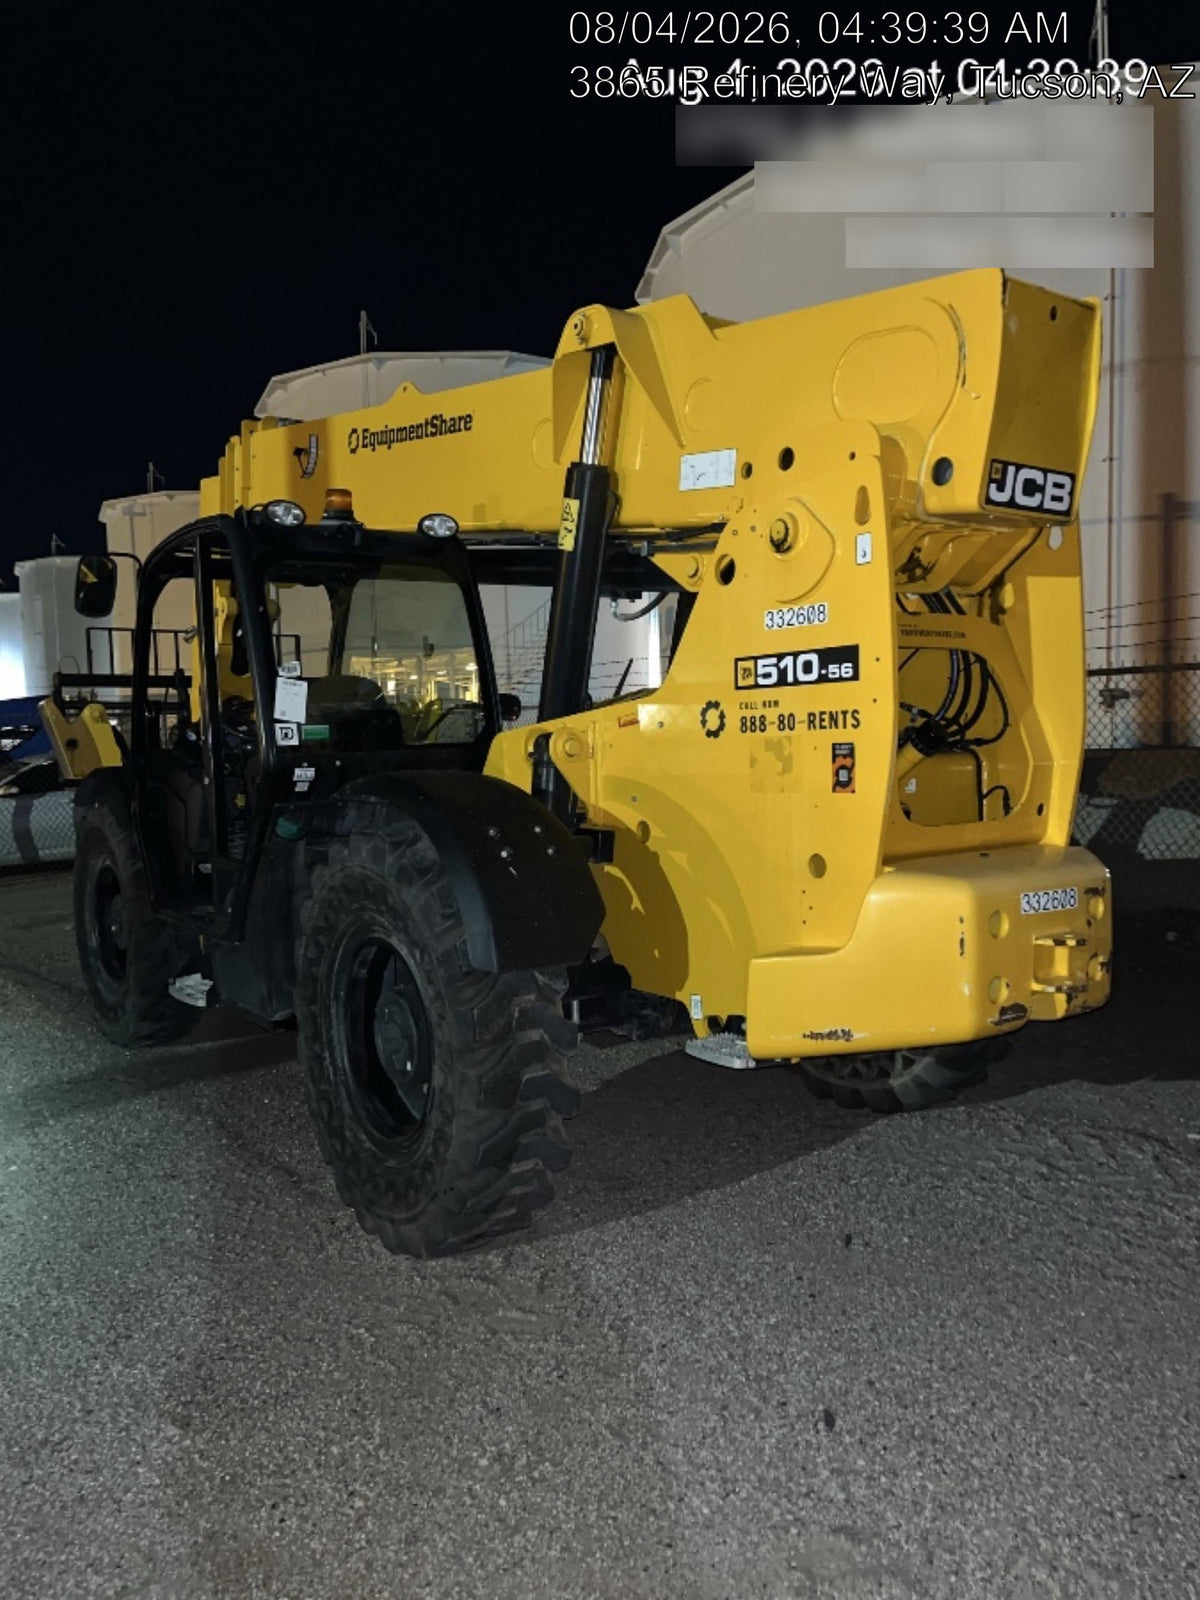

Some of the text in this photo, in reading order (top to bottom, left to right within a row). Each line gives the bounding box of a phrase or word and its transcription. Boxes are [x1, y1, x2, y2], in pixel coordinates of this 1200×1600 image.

[361, 413, 474, 452] EquipmentShare
[988, 465, 1073, 512] JCB
[765, 604, 827, 629] 332608
[739, 709, 861, 734] 888-80-RENTS
[1022, 888, 1077, 913] 332608
